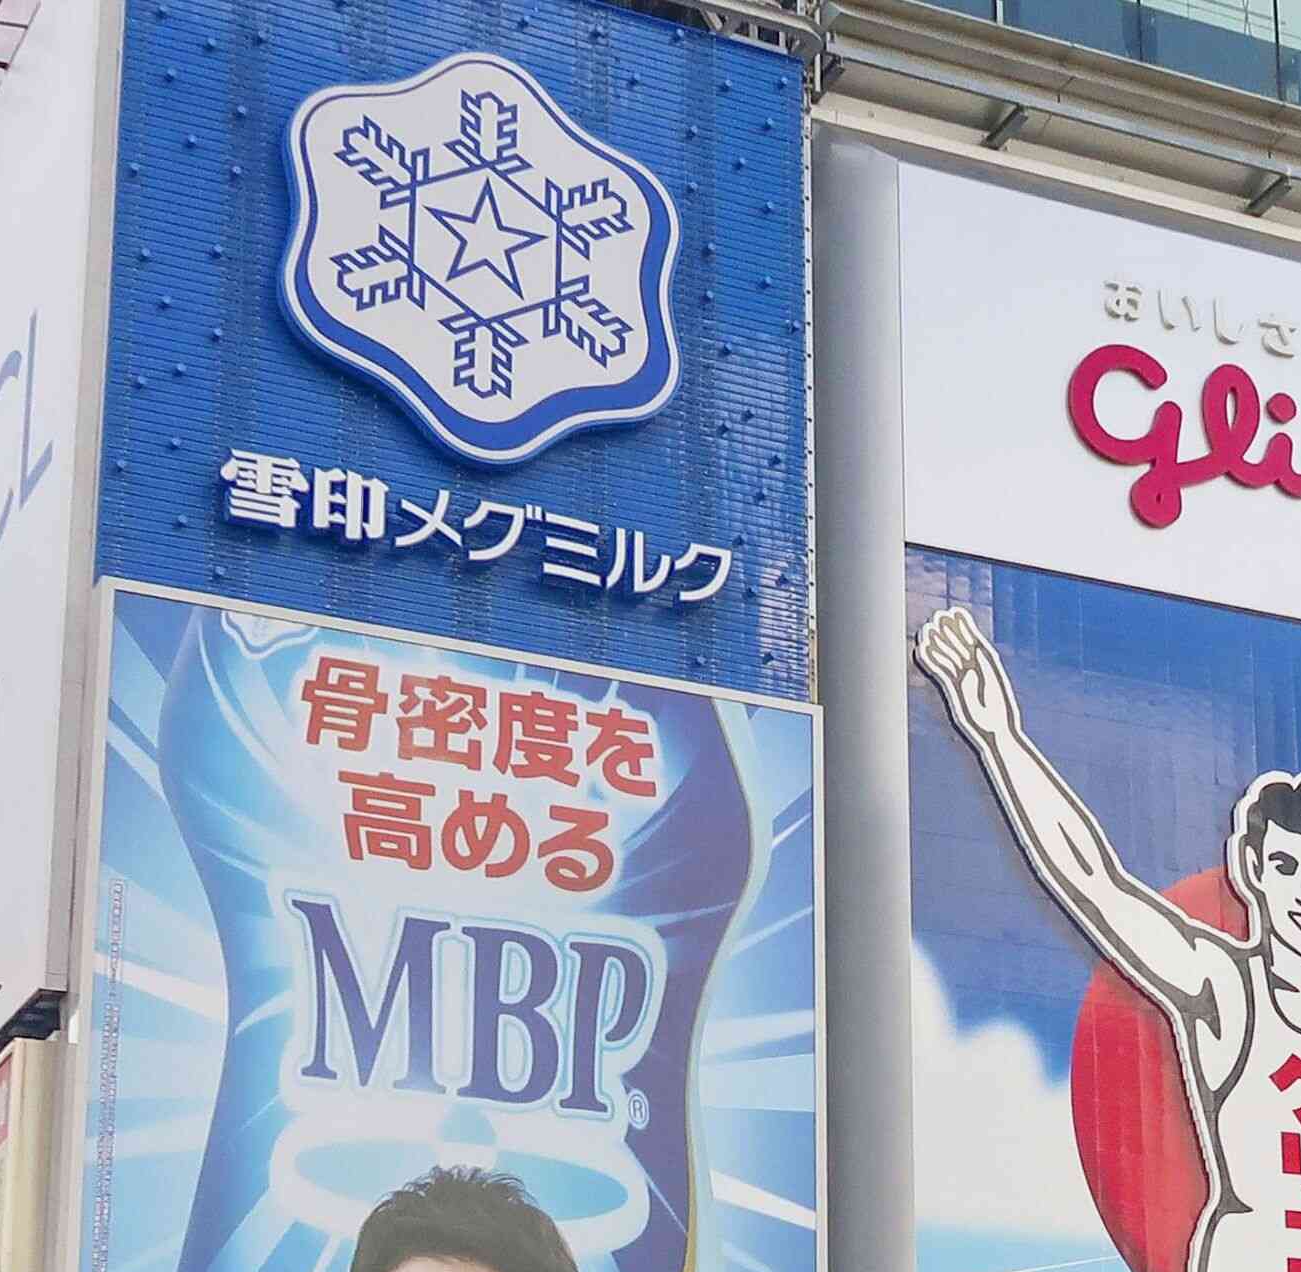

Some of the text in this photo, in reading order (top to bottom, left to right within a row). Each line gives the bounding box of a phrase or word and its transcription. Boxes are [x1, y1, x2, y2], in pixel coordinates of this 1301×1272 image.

[220, 448, 733, 602] 雪印メグミルク
[299, 654, 658, 799] 骨密度を
[337, 770, 616, 893] 高める
[289, 898, 652, 1115] MBP
